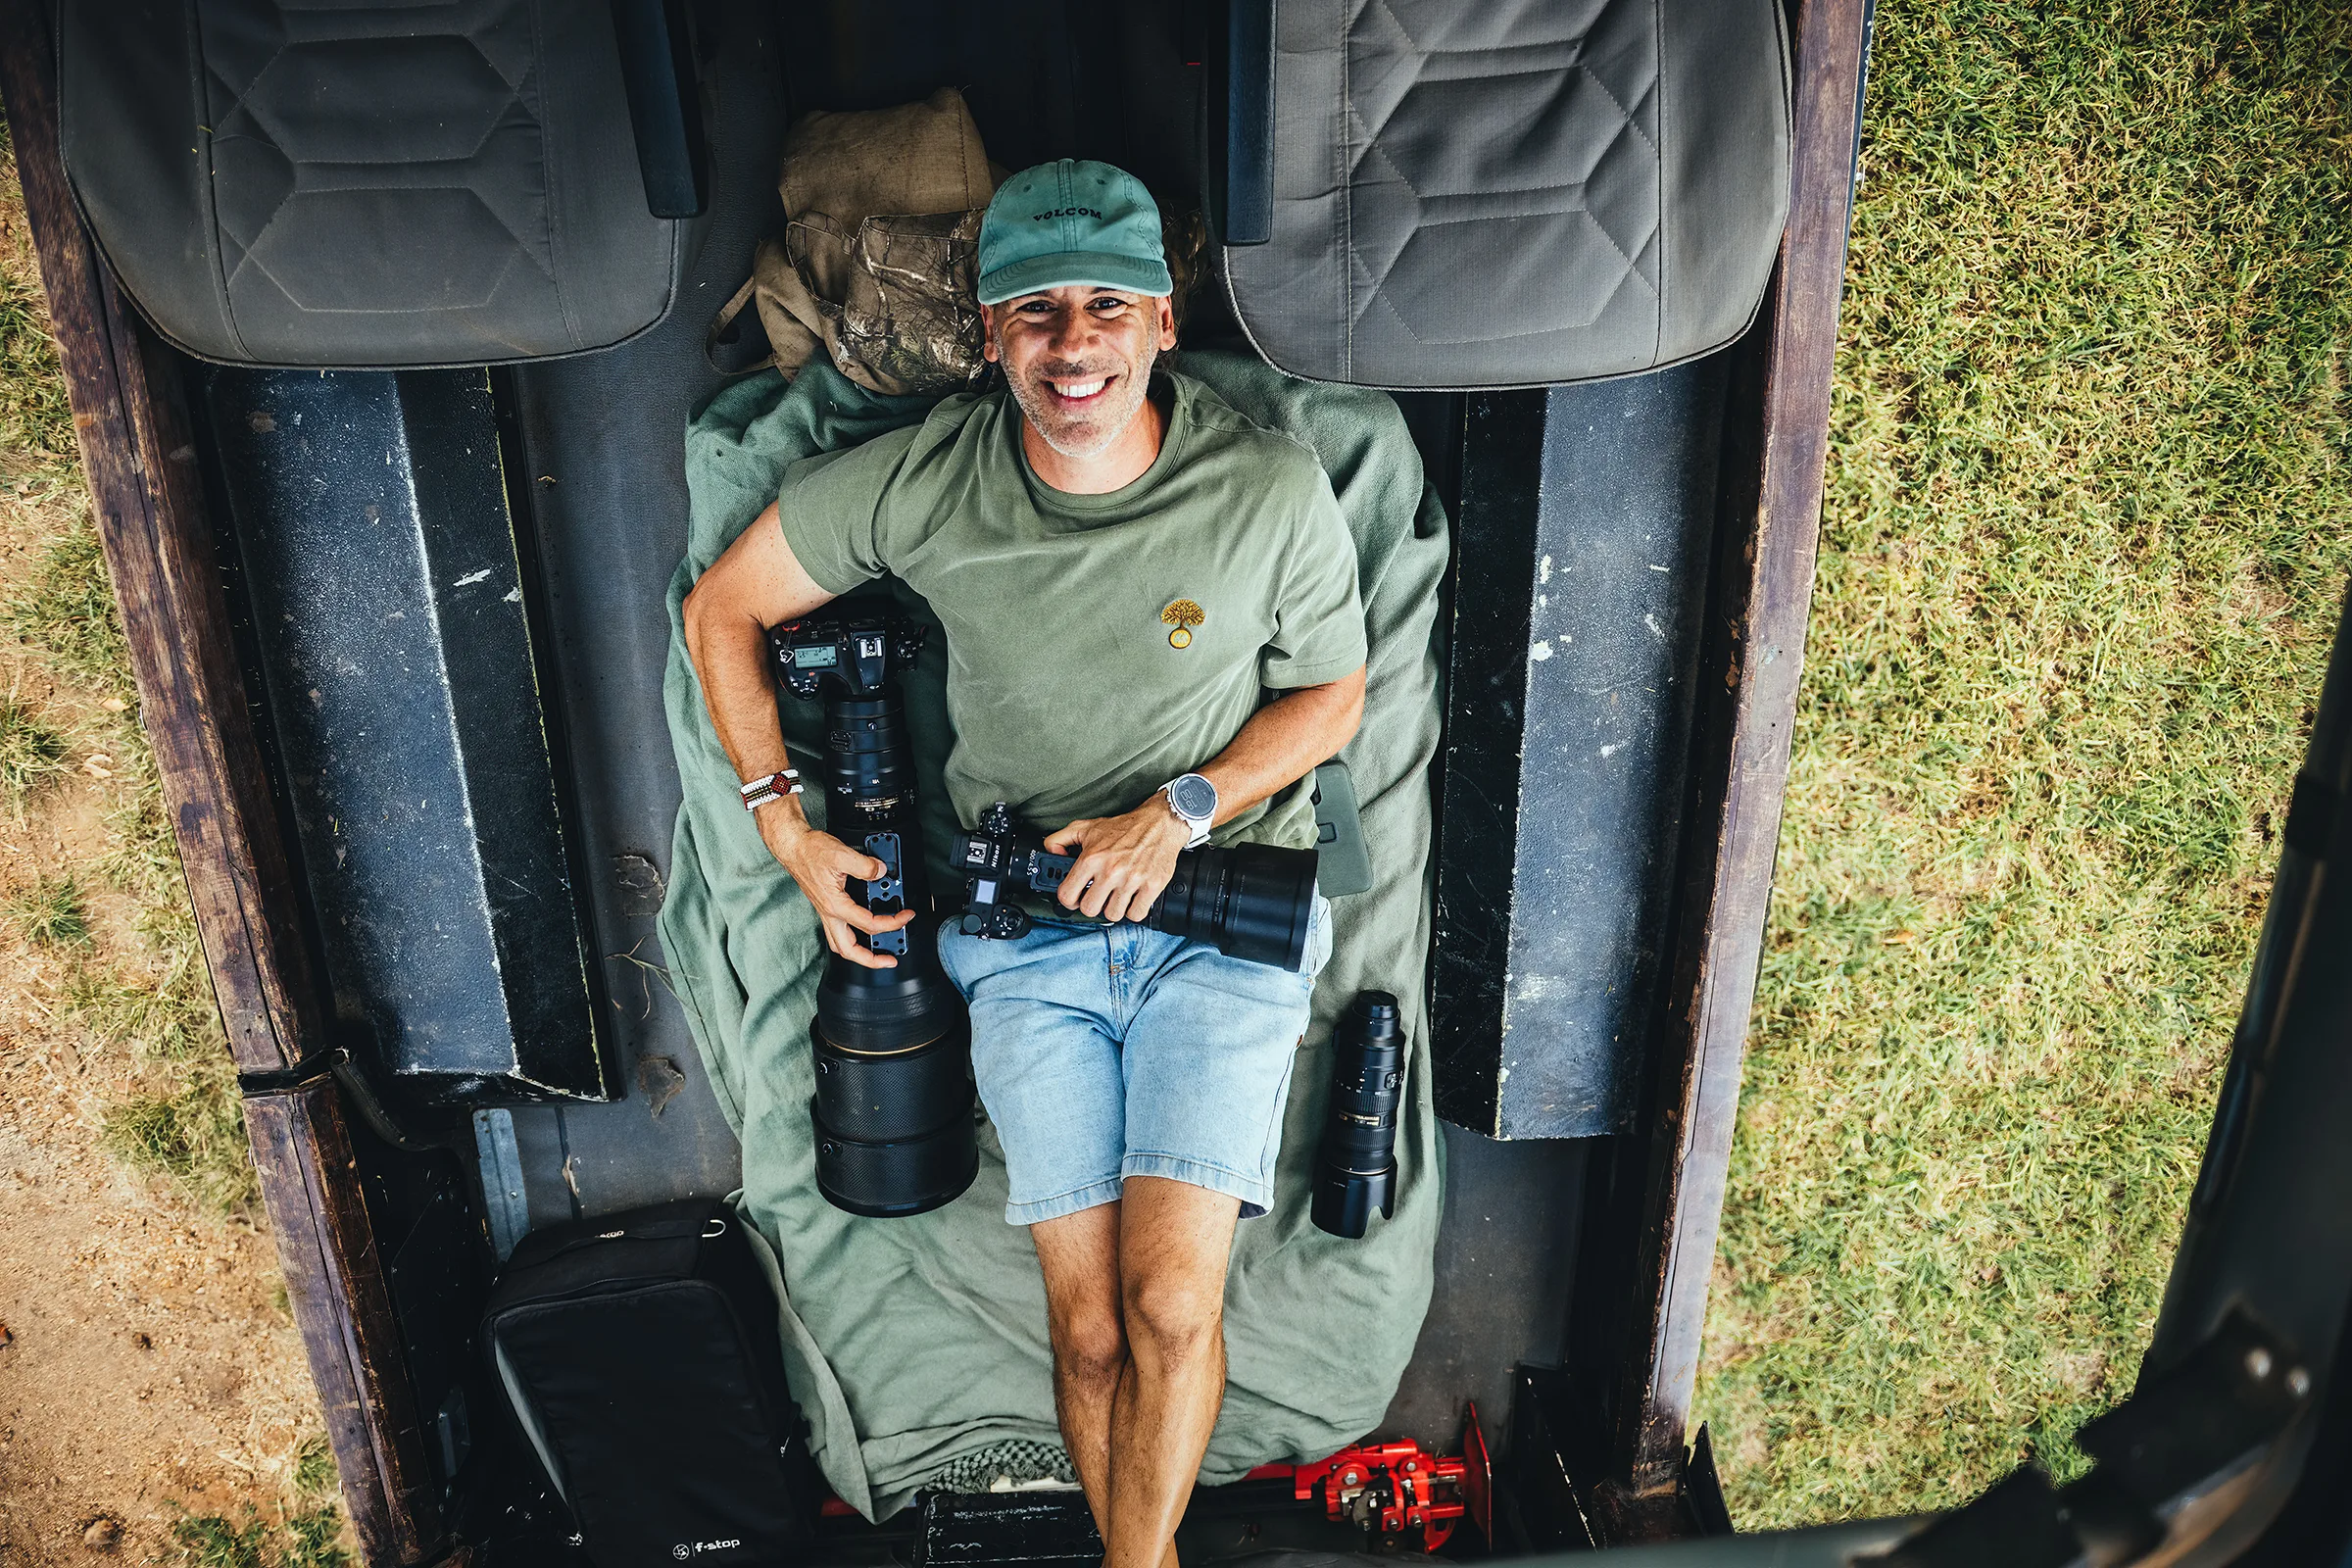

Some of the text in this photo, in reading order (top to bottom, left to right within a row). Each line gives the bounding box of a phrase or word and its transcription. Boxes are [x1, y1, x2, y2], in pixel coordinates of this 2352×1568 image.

[1033, 207, 1102, 221] VOLCOM
[991, 844, 1001, 868] Nikon
[694, 1539, 741, 1552] f-stop
